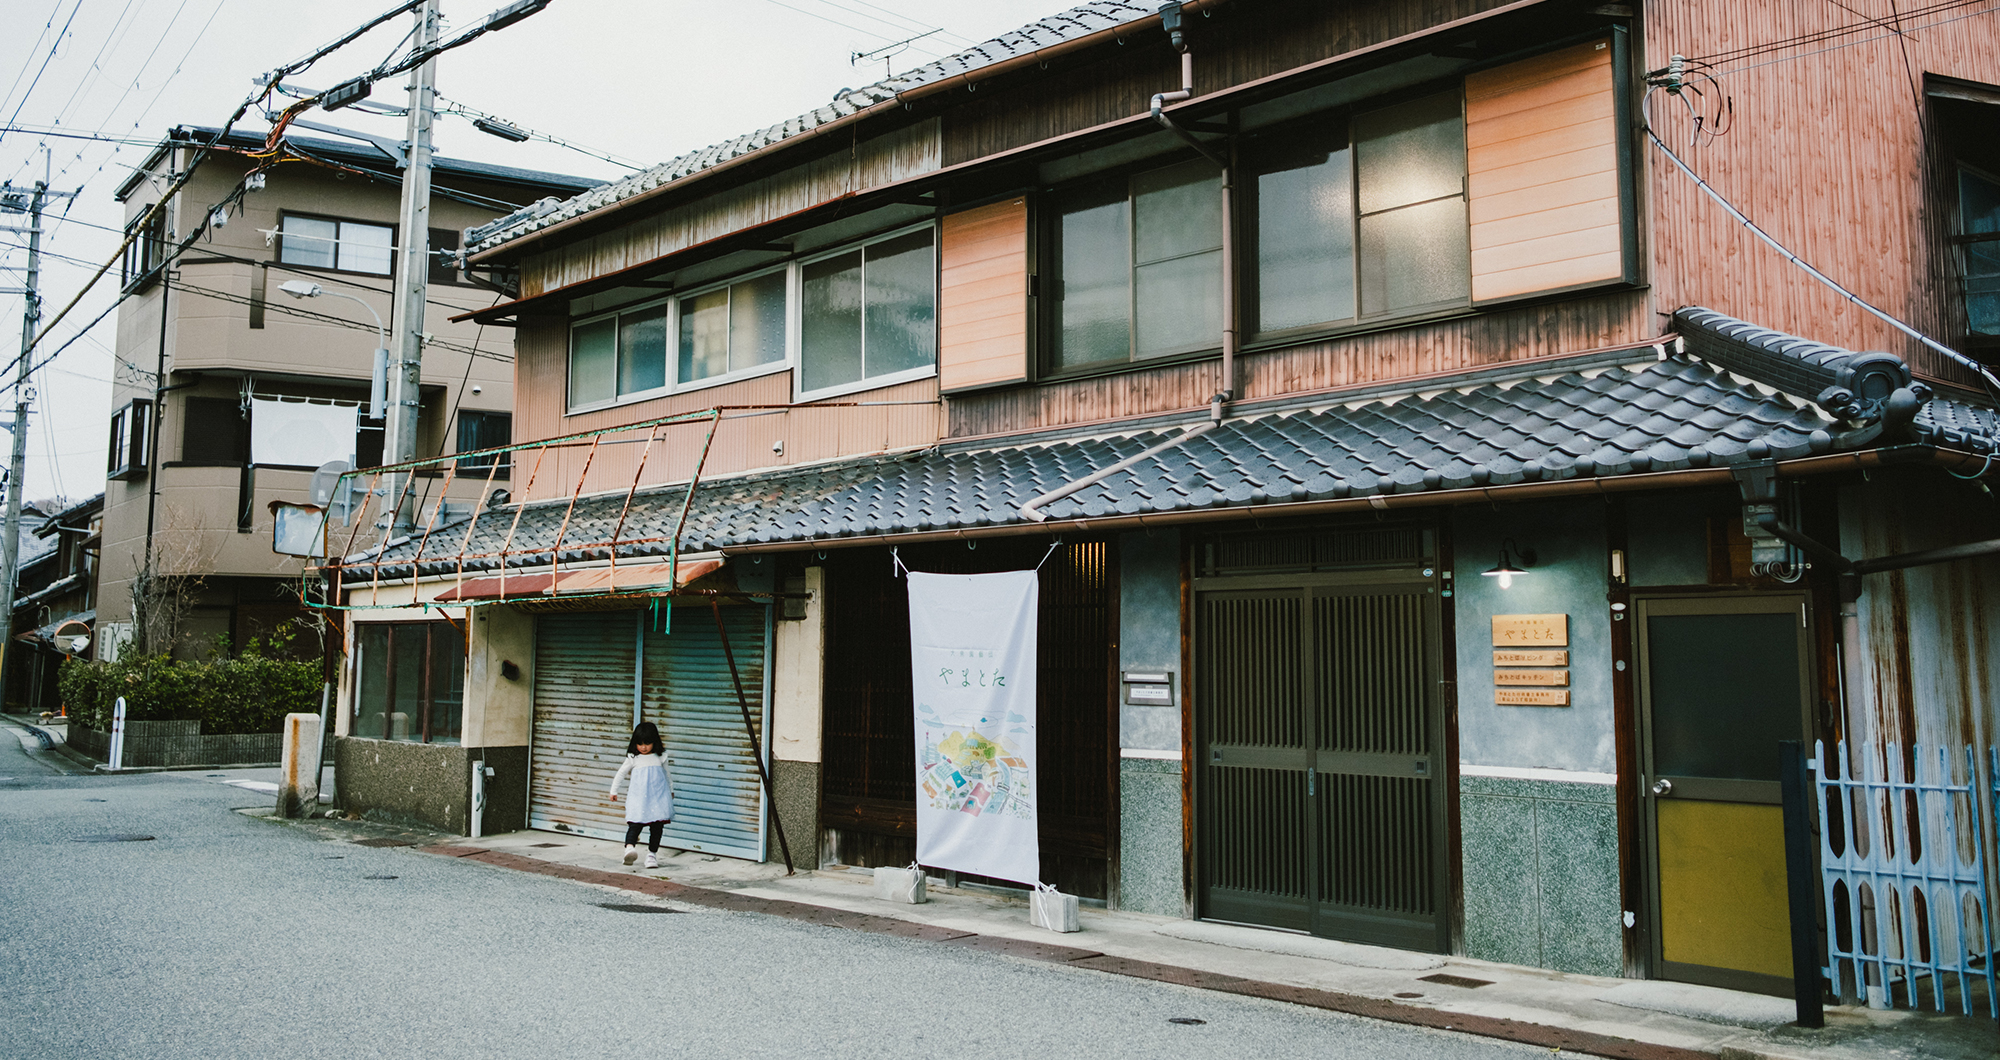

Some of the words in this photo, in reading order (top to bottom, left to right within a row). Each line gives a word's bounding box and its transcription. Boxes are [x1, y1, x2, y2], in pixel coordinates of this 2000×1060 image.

[1504, 628, 1554, 641] やまとた
[939, 667, 1006, 687] やまとた
